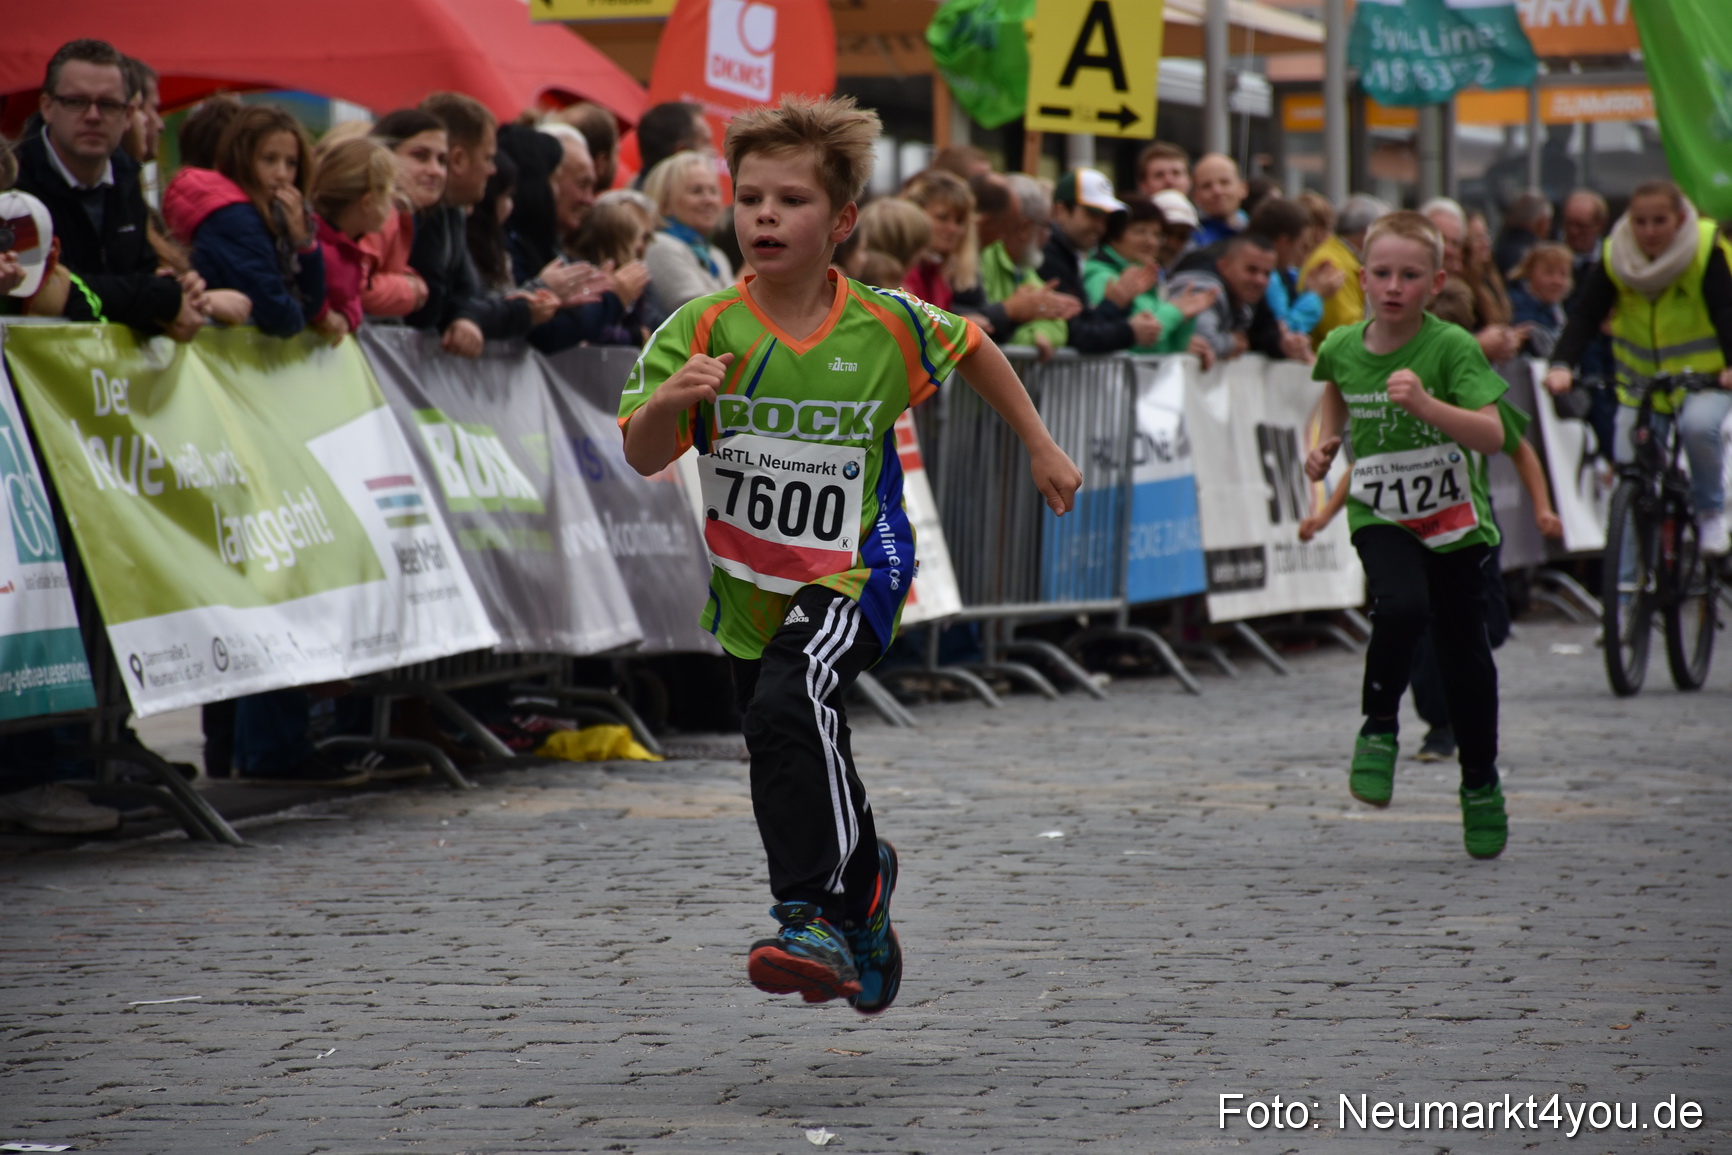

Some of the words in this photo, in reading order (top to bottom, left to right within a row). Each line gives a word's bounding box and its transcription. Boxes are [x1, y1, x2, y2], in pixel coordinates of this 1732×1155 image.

[1058, 0, 1129, 93] A
[711, 54, 767, 90] DKMS
[714, 393, 883, 441] BOCK
[1344, 391, 1389, 403] umarkt
[710, 448, 755, 466] ARTL
[759, 453, 837, 476] Neumarkt
[1354, 465, 1389, 479] PARTL
[1391, 458, 1445, 473] Neumarkt
[715, 467, 846, 542] 7600
[1363, 468, 1461, 515] 7124
